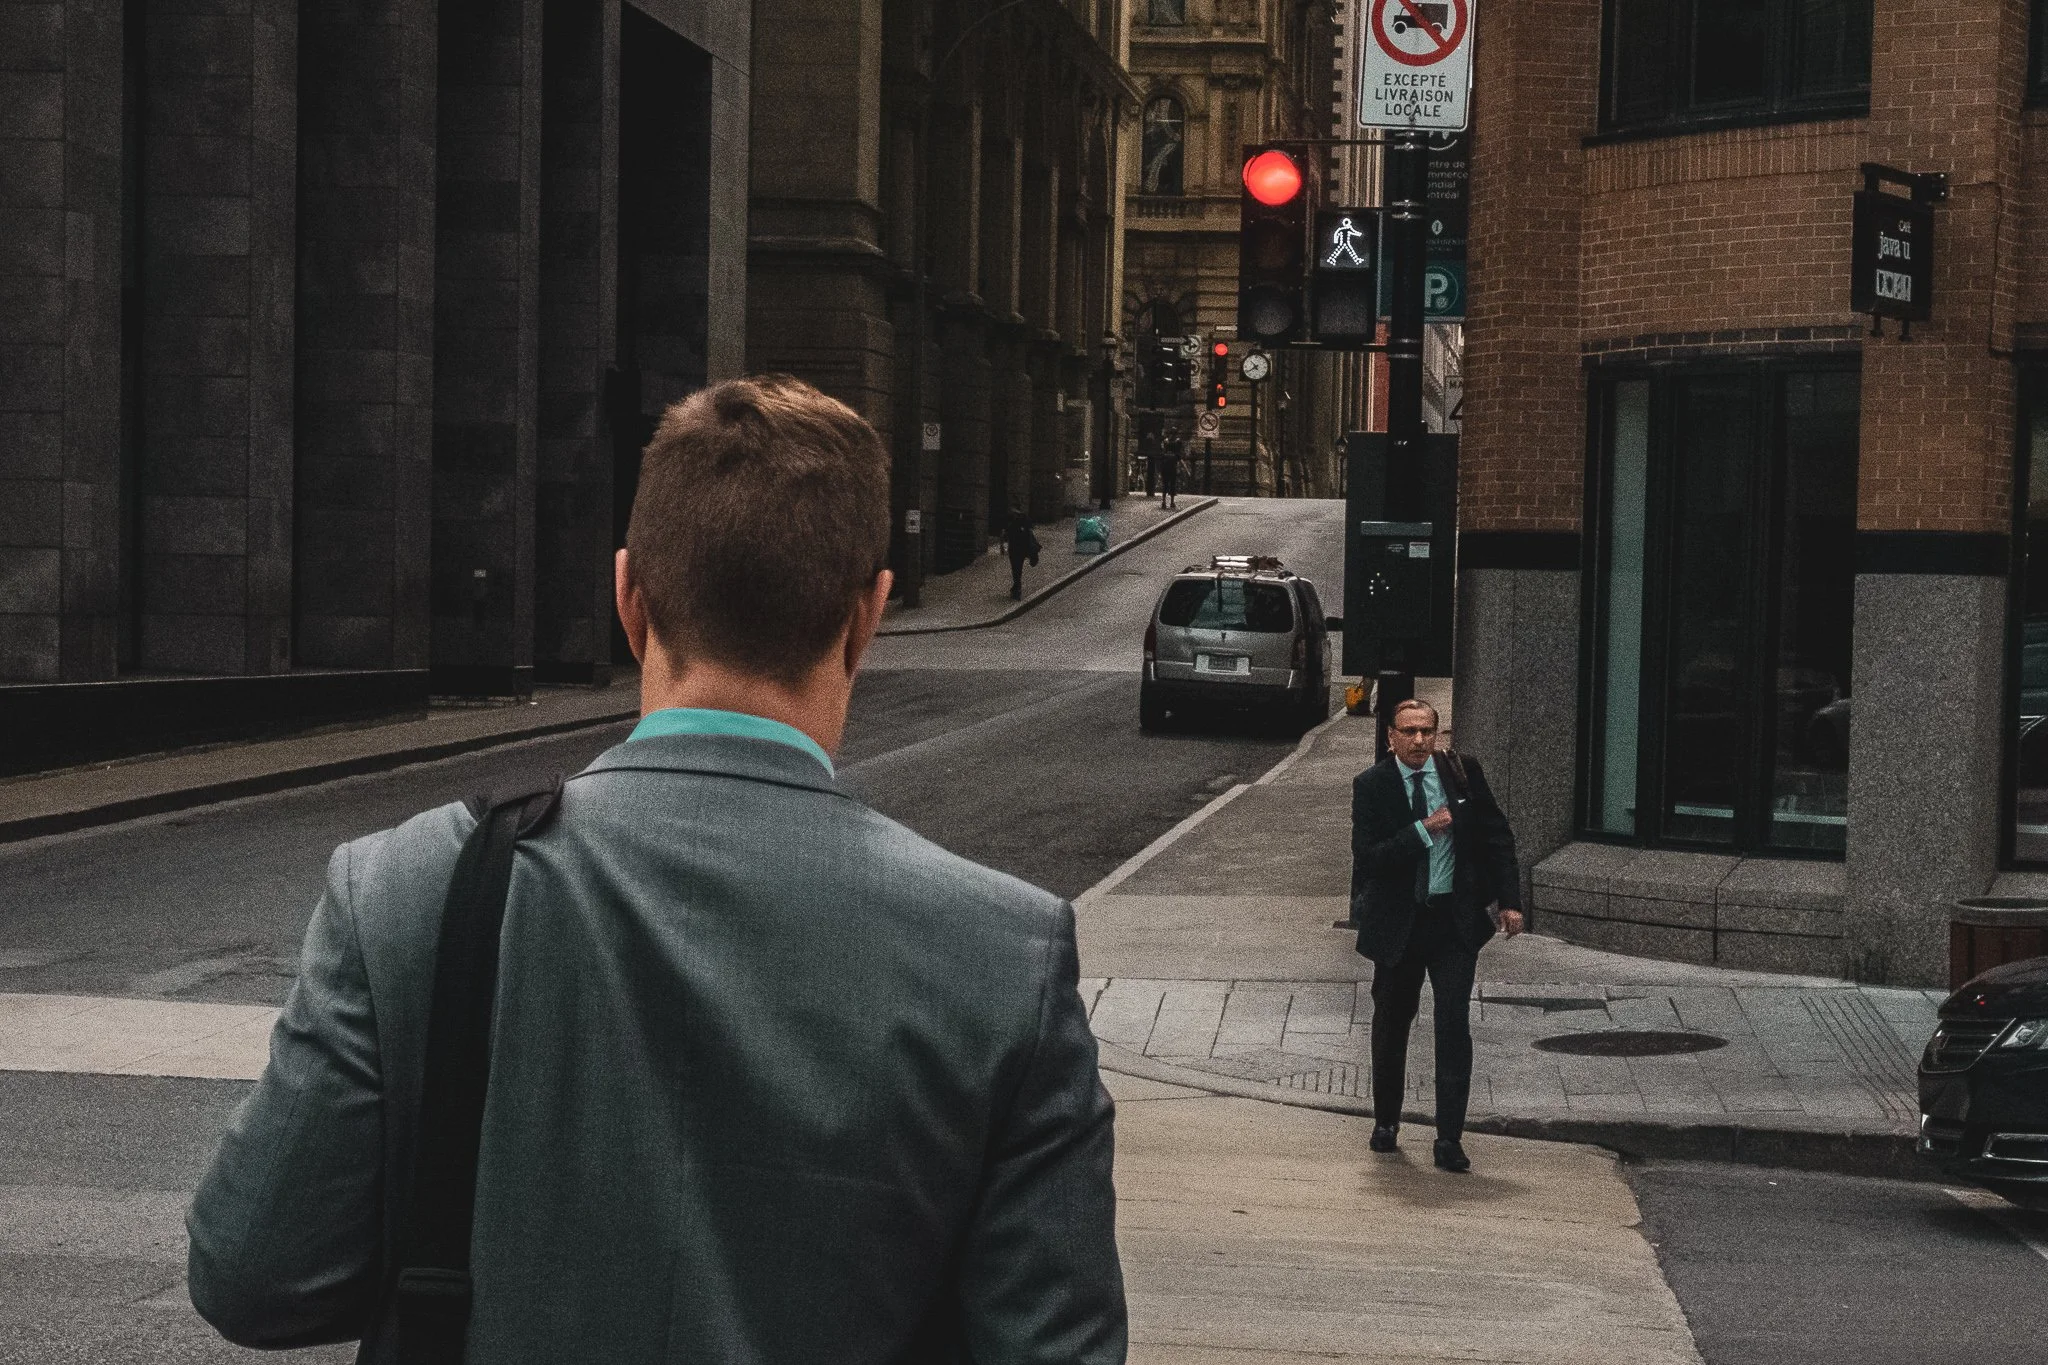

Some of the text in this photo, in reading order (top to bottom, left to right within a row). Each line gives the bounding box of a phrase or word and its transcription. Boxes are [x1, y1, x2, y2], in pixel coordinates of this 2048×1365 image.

[1383, 73, 1446, 87] EXCEPTÉ
[1375, 88, 1453, 103] LIVRAISON
[1385, 103, 1441, 117] LOCALE
[1428, 160, 1465, 168] ntre de
[1427, 171, 1469, 179] mmerce
[1427, 180, 1456, 189] ndial
[1427, 190, 1460, 199] ntréal
[1877, 231, 1901, 260] java
[1424, 273, 1448, 307] P
